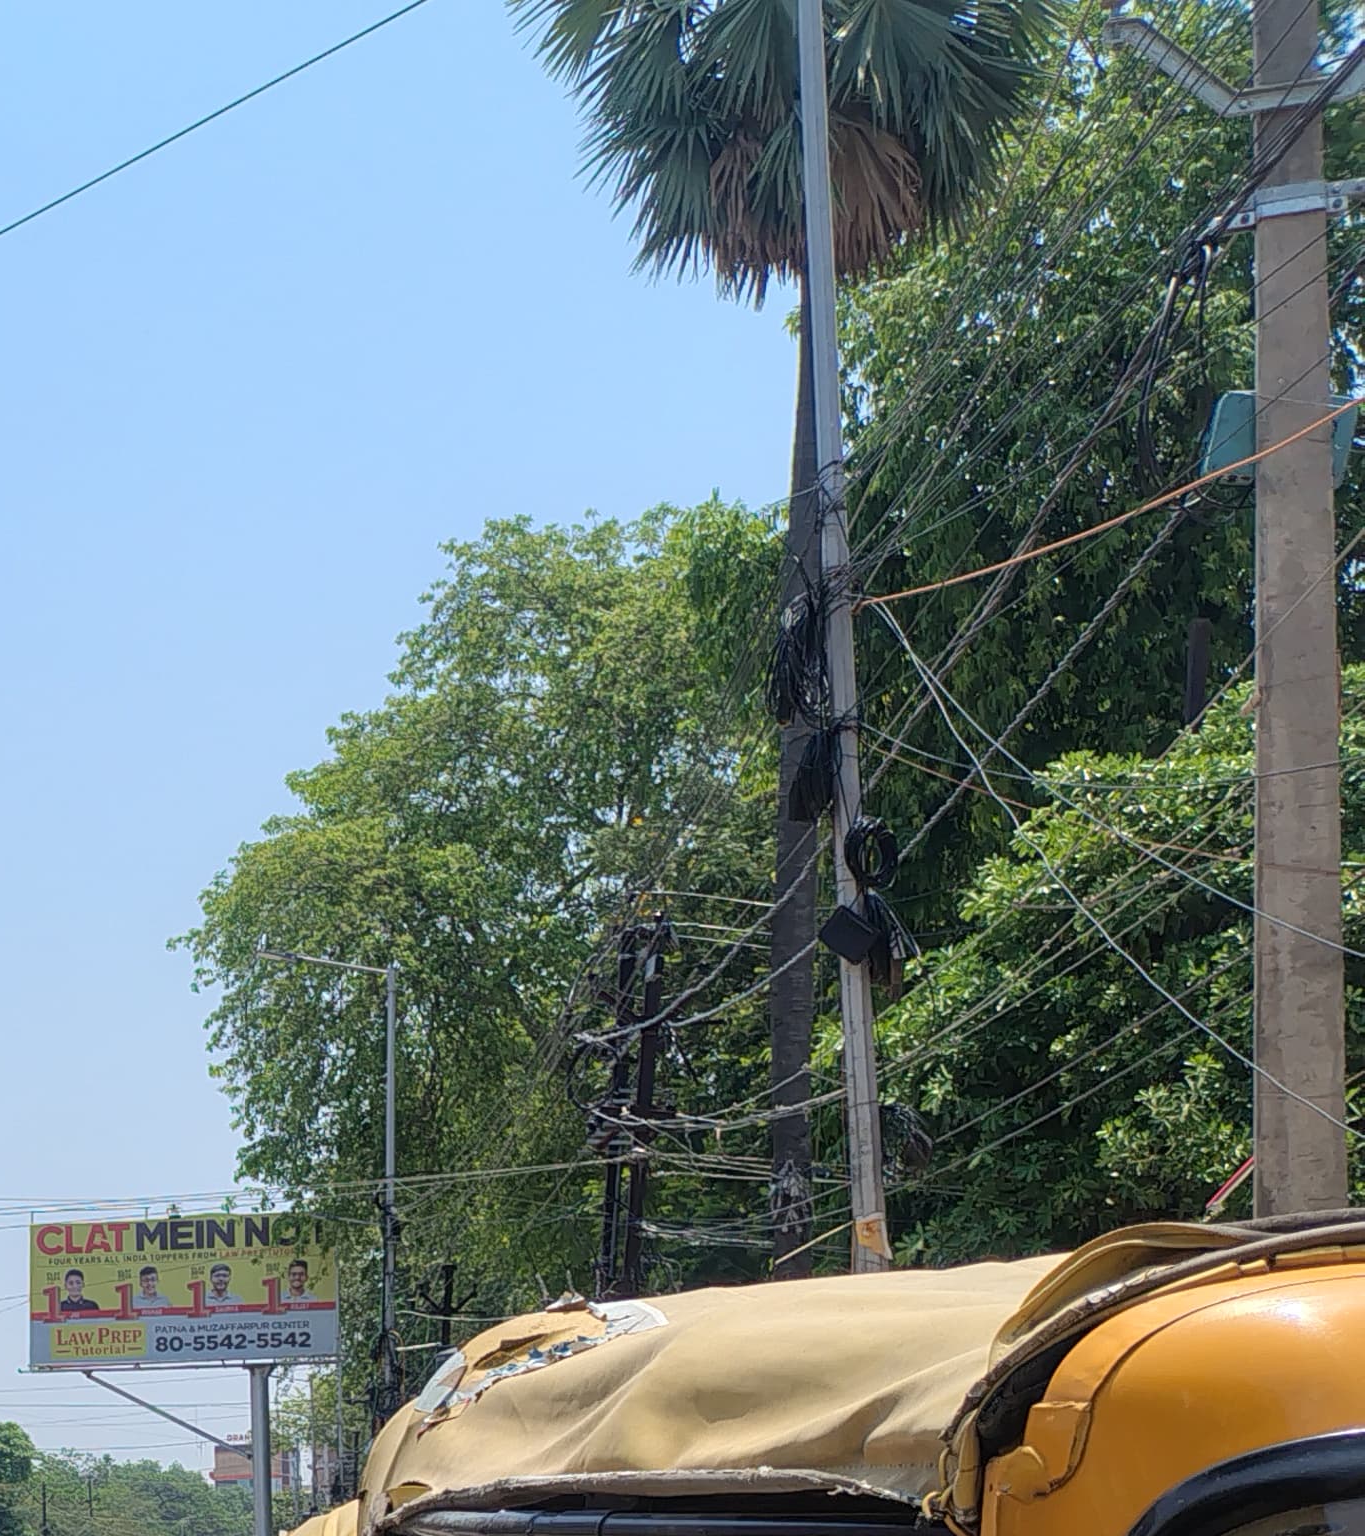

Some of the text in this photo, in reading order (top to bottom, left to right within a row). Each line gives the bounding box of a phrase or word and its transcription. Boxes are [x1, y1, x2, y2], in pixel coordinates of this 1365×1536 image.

[35, 1218, 235, 1256] CLAT MEIN
[48, 1255, 73, 1266] FOUR
[74, 1254, 102, 1265] YEARS
[104, 1254, 120, 1264] ALL
[122, 1252, 148, 1263] INDIA
[150, 1252, 190, 1263] TOPPERS
[192, 1250, 217, 1260] FROM
[97, 1326, 143, 1345] PREP
[154, 1320, 310, 1334] PATNA MUZAFFARPUR CENTER
[155, 1331, 312, 1352] 80-5542-5542
[74, 1345, 126, 1357] Tutorial
